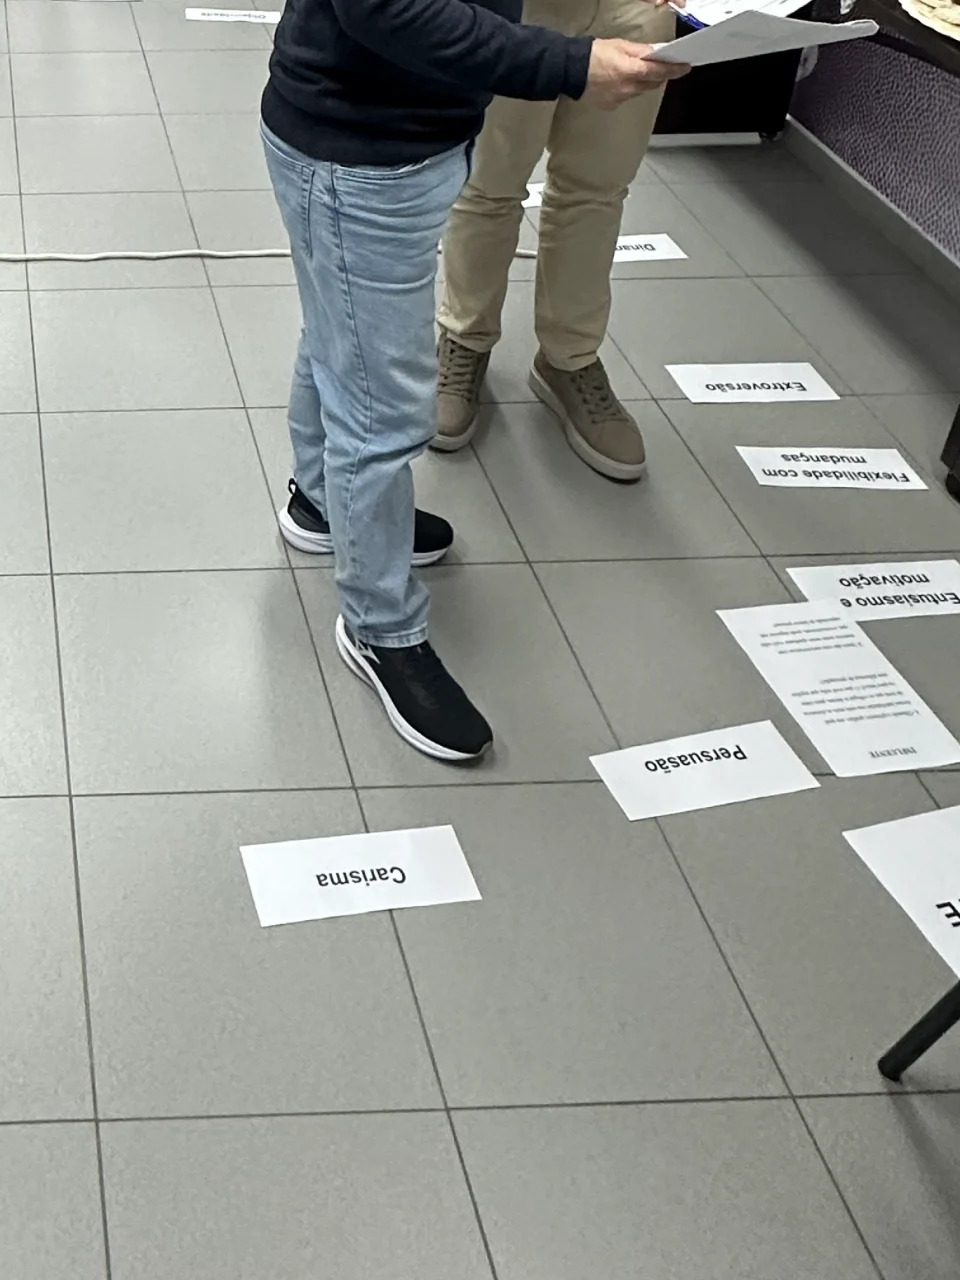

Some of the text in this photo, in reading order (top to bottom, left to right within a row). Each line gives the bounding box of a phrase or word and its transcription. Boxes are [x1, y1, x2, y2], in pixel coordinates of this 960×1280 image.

[705, 379, 807, 395] Extroversão
[780, 452, 868, 466] mudanças
[762, 469, 911, 484] Flexibilidade com
[838, 573, 931, 589] motivação
[839, 591, 960, 610] Entusiasmo e
[644, 743, 748, 775] Persuasão
[315, 865, 407, 888] Carisma
